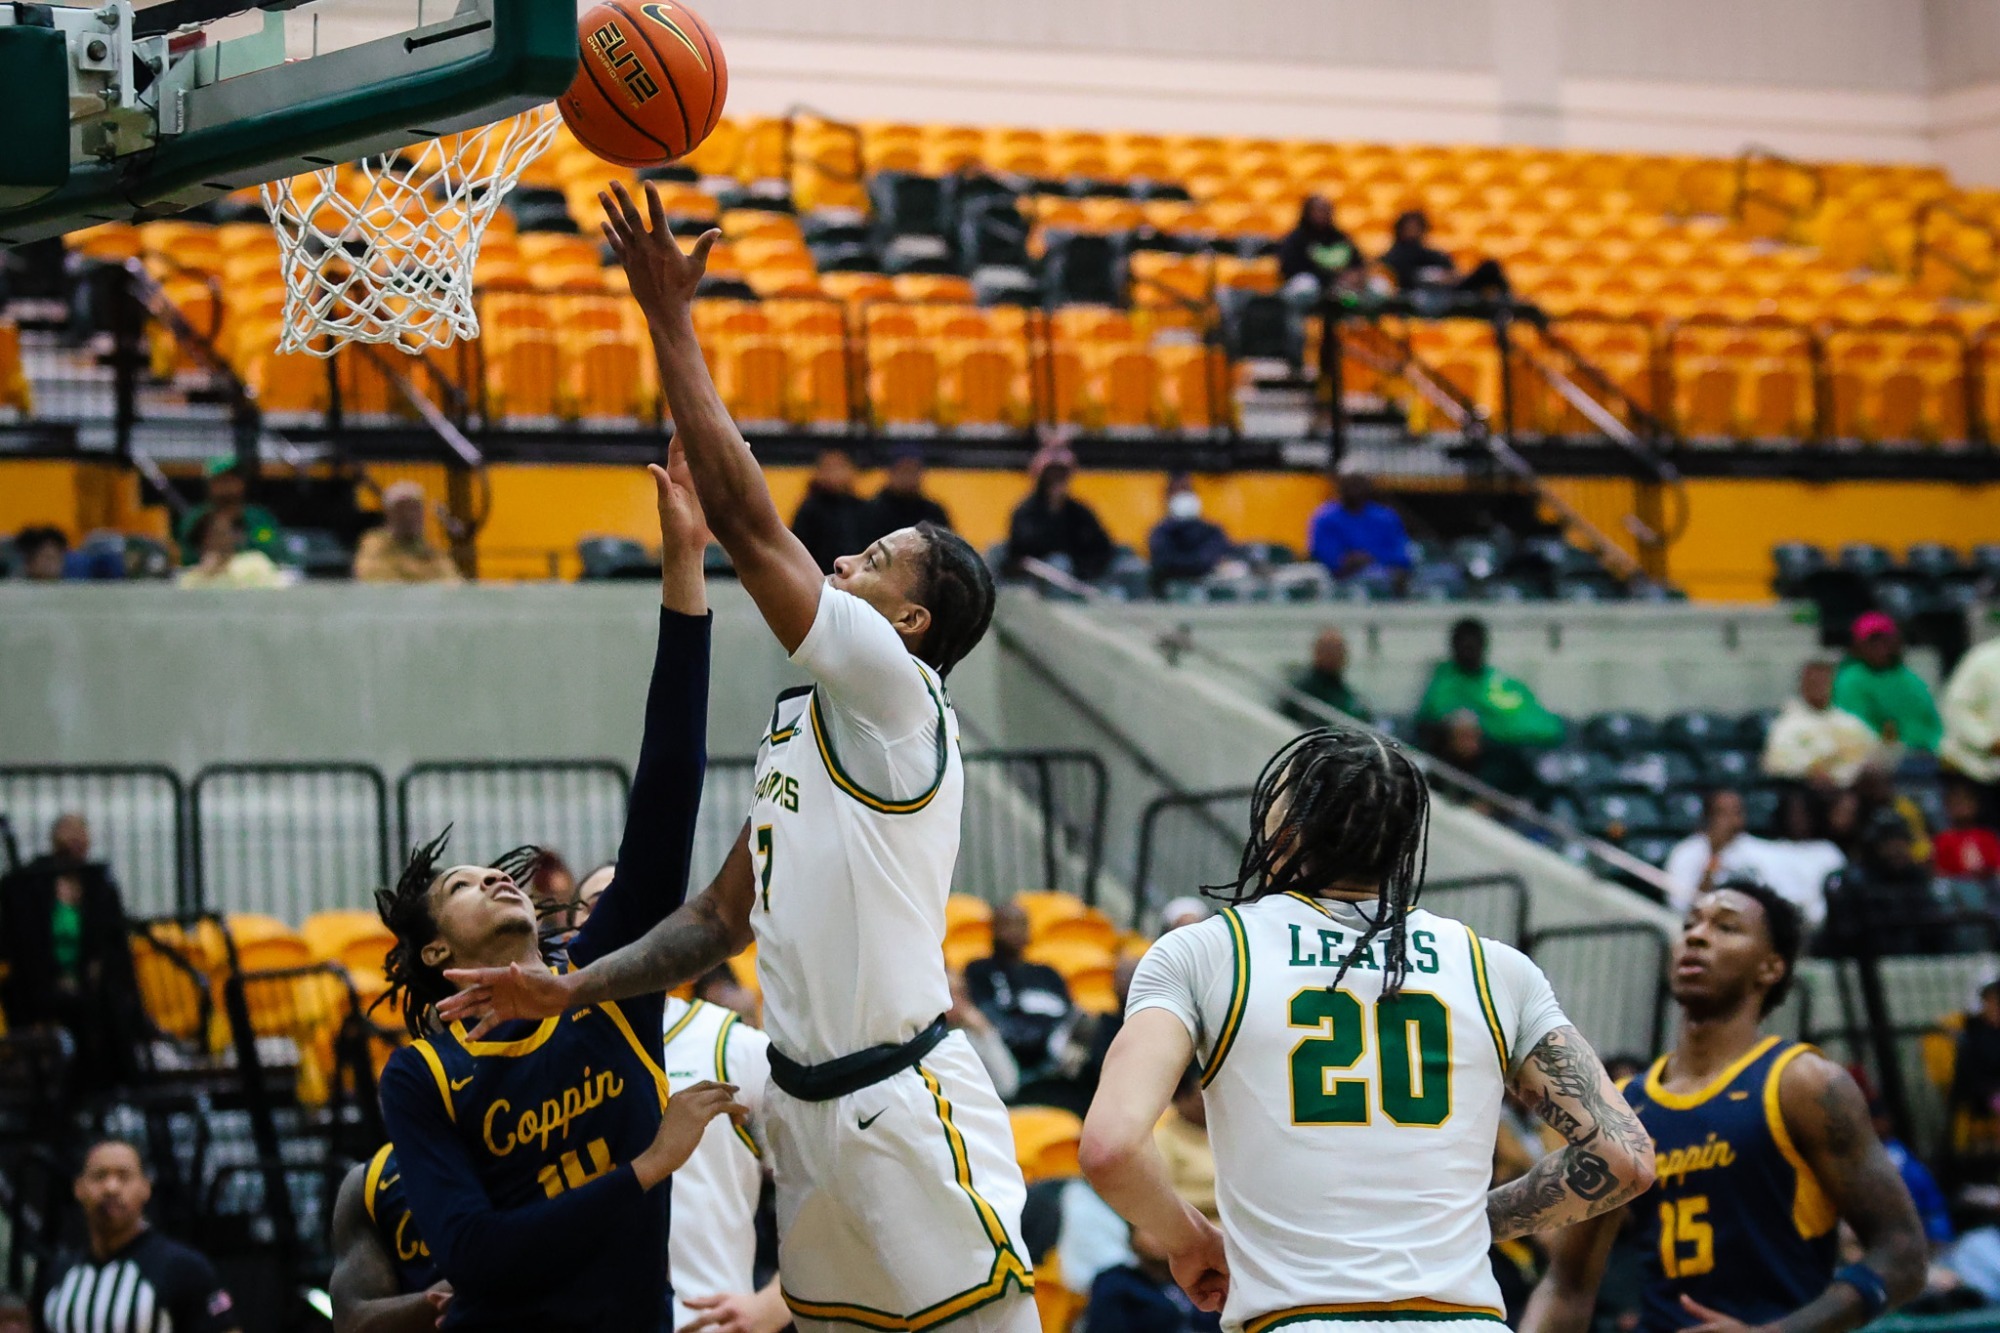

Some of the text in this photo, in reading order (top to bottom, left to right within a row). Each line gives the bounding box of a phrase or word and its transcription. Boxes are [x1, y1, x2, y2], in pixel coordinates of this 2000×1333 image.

[587, 36, 640, 109] CHAMPIONP
[593, 21, 660, 104] ELITE
[757, 824, 773, 913] 7
[1287, 986, 1453, 1129] 20
[483, 1066, 624, 1157] Coppin
[1659, 1195, 1715, 1279] 15
